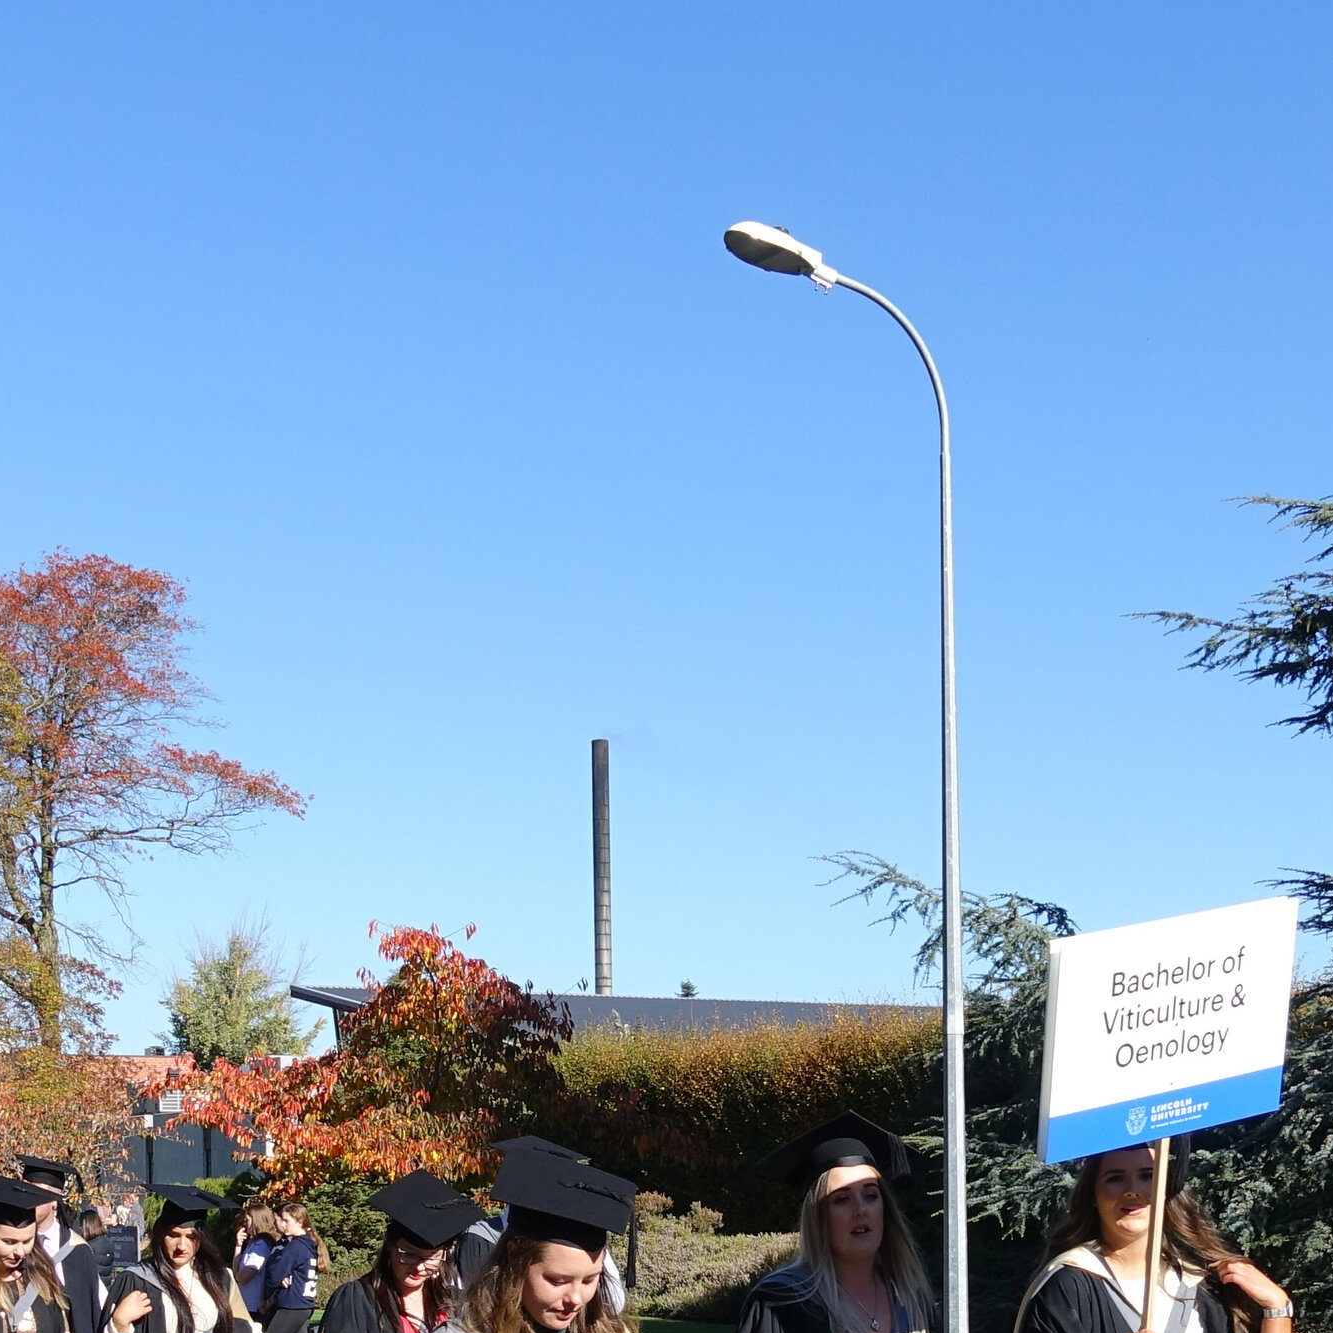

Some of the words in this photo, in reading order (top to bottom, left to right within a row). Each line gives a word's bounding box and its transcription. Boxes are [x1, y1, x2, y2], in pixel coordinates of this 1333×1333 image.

[1111, 957, 1215, 997] Bachelor
[1222, 945, 1246, 972] of
[1103, 992, 1223, 1035] Viticulture
[1230, 984, 1246, 1007] &
[1115, 1026, 1229, 1068] Oenology
[1150, 1102, 1210, 1122] UNIVERSITY
[1151, 1097, 1193, 1114] LINCOLN
